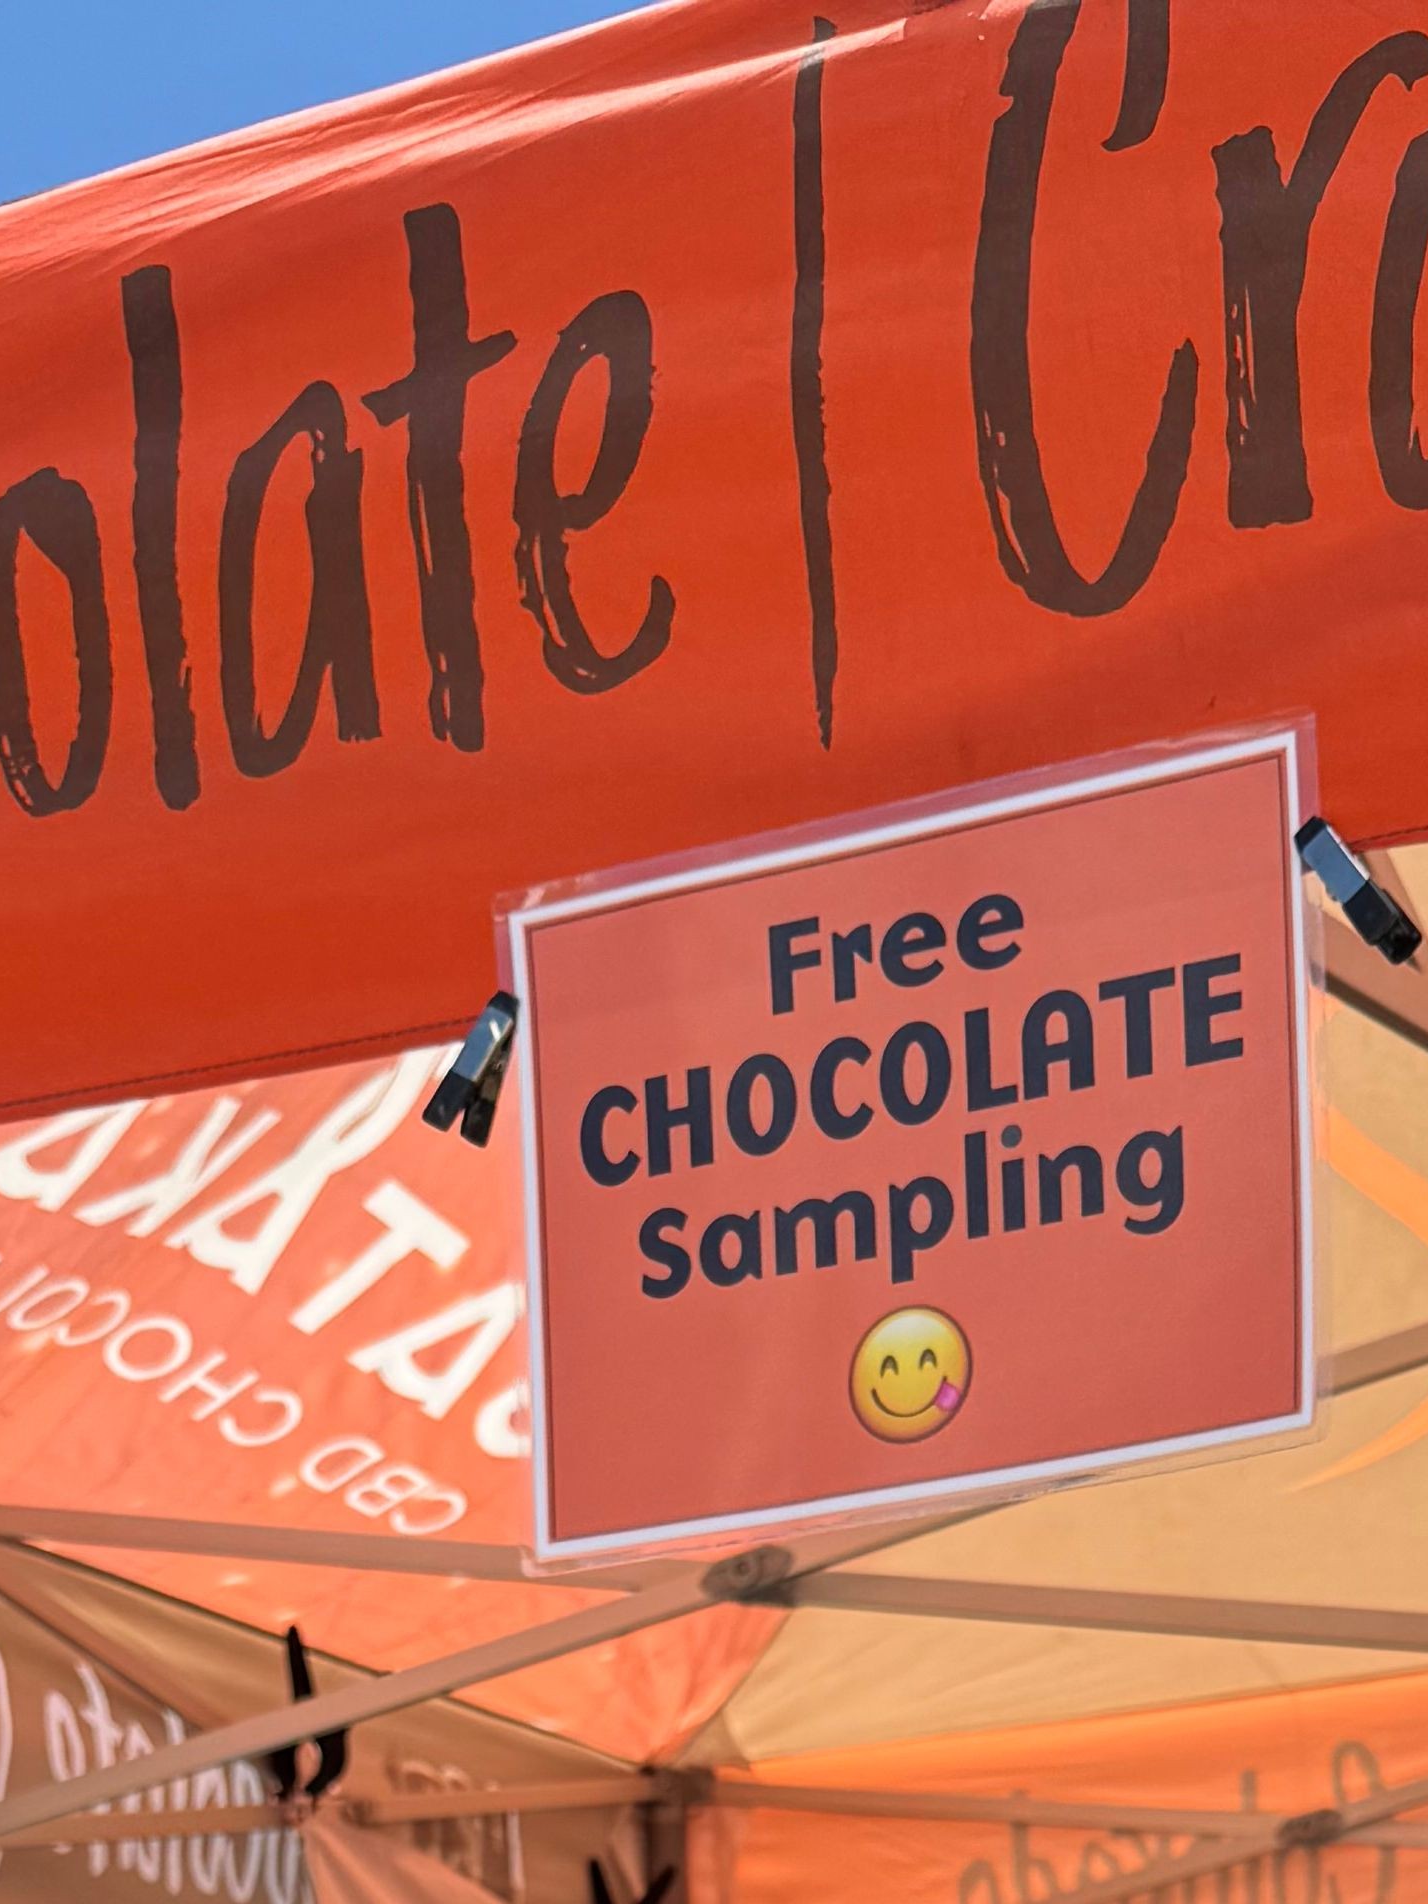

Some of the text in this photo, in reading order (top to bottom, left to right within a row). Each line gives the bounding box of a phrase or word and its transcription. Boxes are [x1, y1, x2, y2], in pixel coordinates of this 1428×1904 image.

[768, 894, 1024, 1014] Free
[580, 953, 1244, 1187] CHOCOLATE
[639, 1124, 1185, 1299] Sampling
